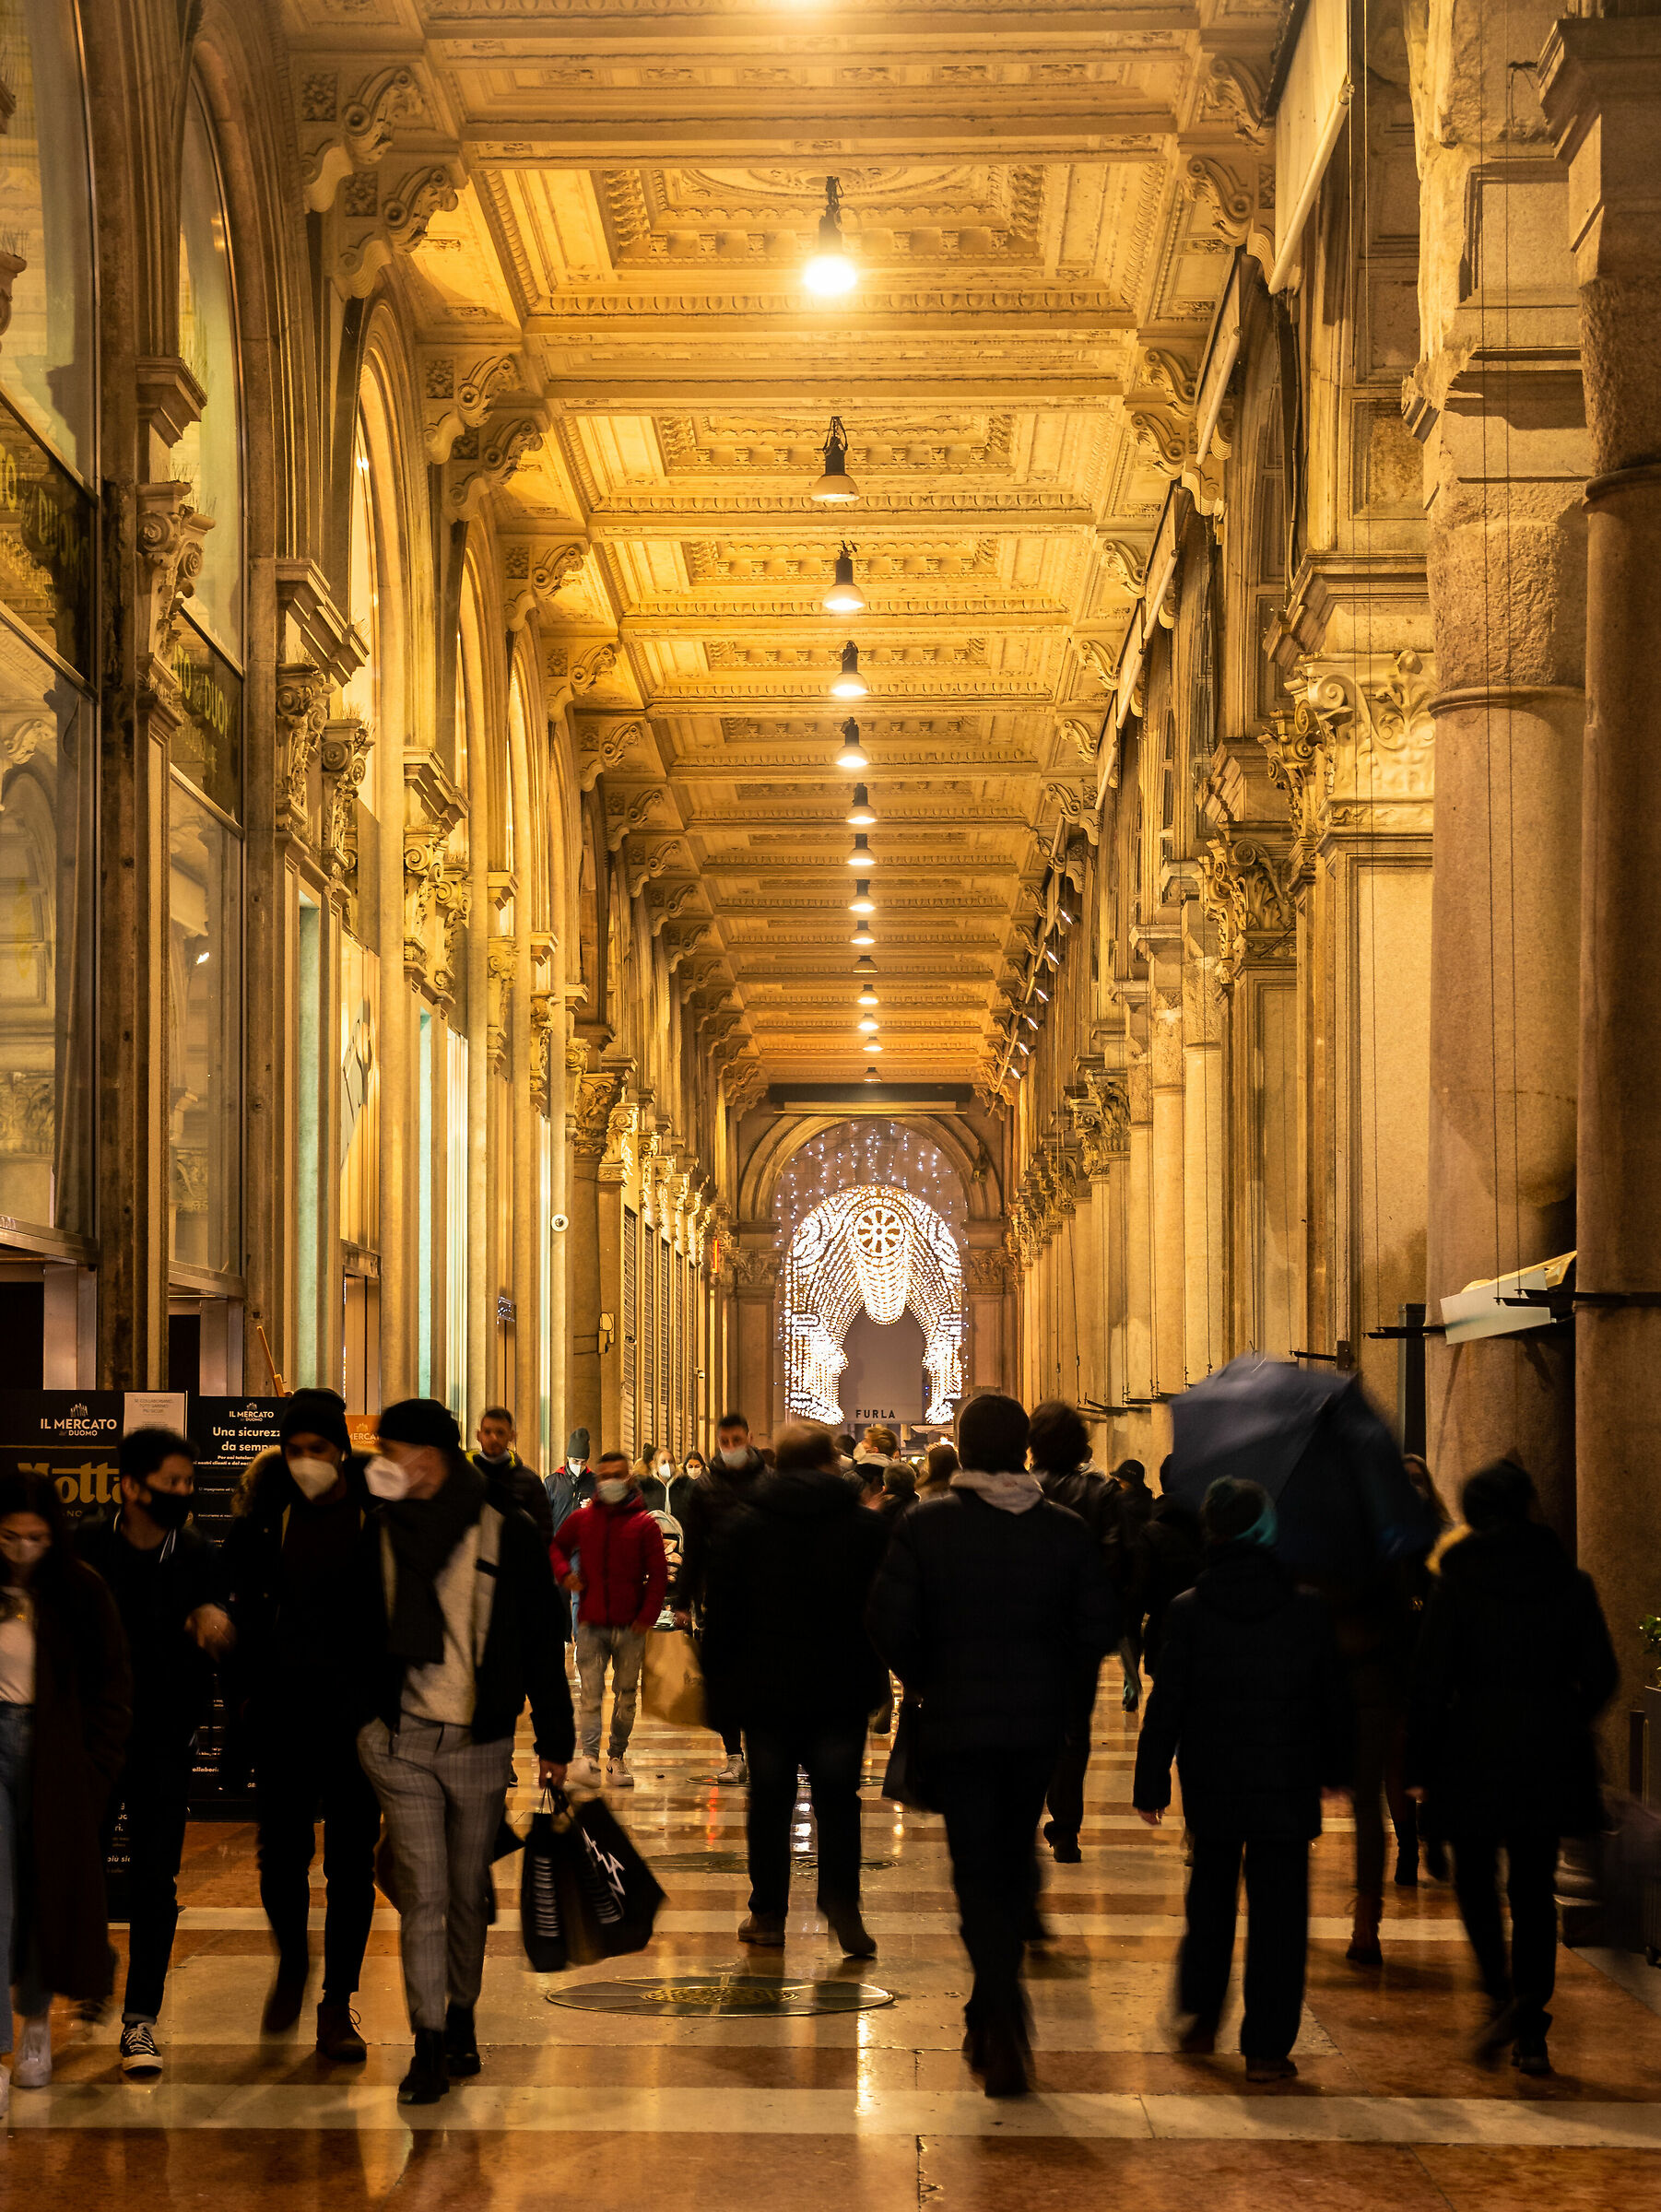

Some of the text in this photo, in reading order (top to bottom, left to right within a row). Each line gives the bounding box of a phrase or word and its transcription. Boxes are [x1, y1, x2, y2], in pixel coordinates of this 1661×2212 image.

[855, 1409, 896, 1418] FURLA
[41, 1418, 117, 1430] IL MERCATO
[213, 1426, 280, 1437] Una sicurezz
[221, 1441, 237, 1451] da
